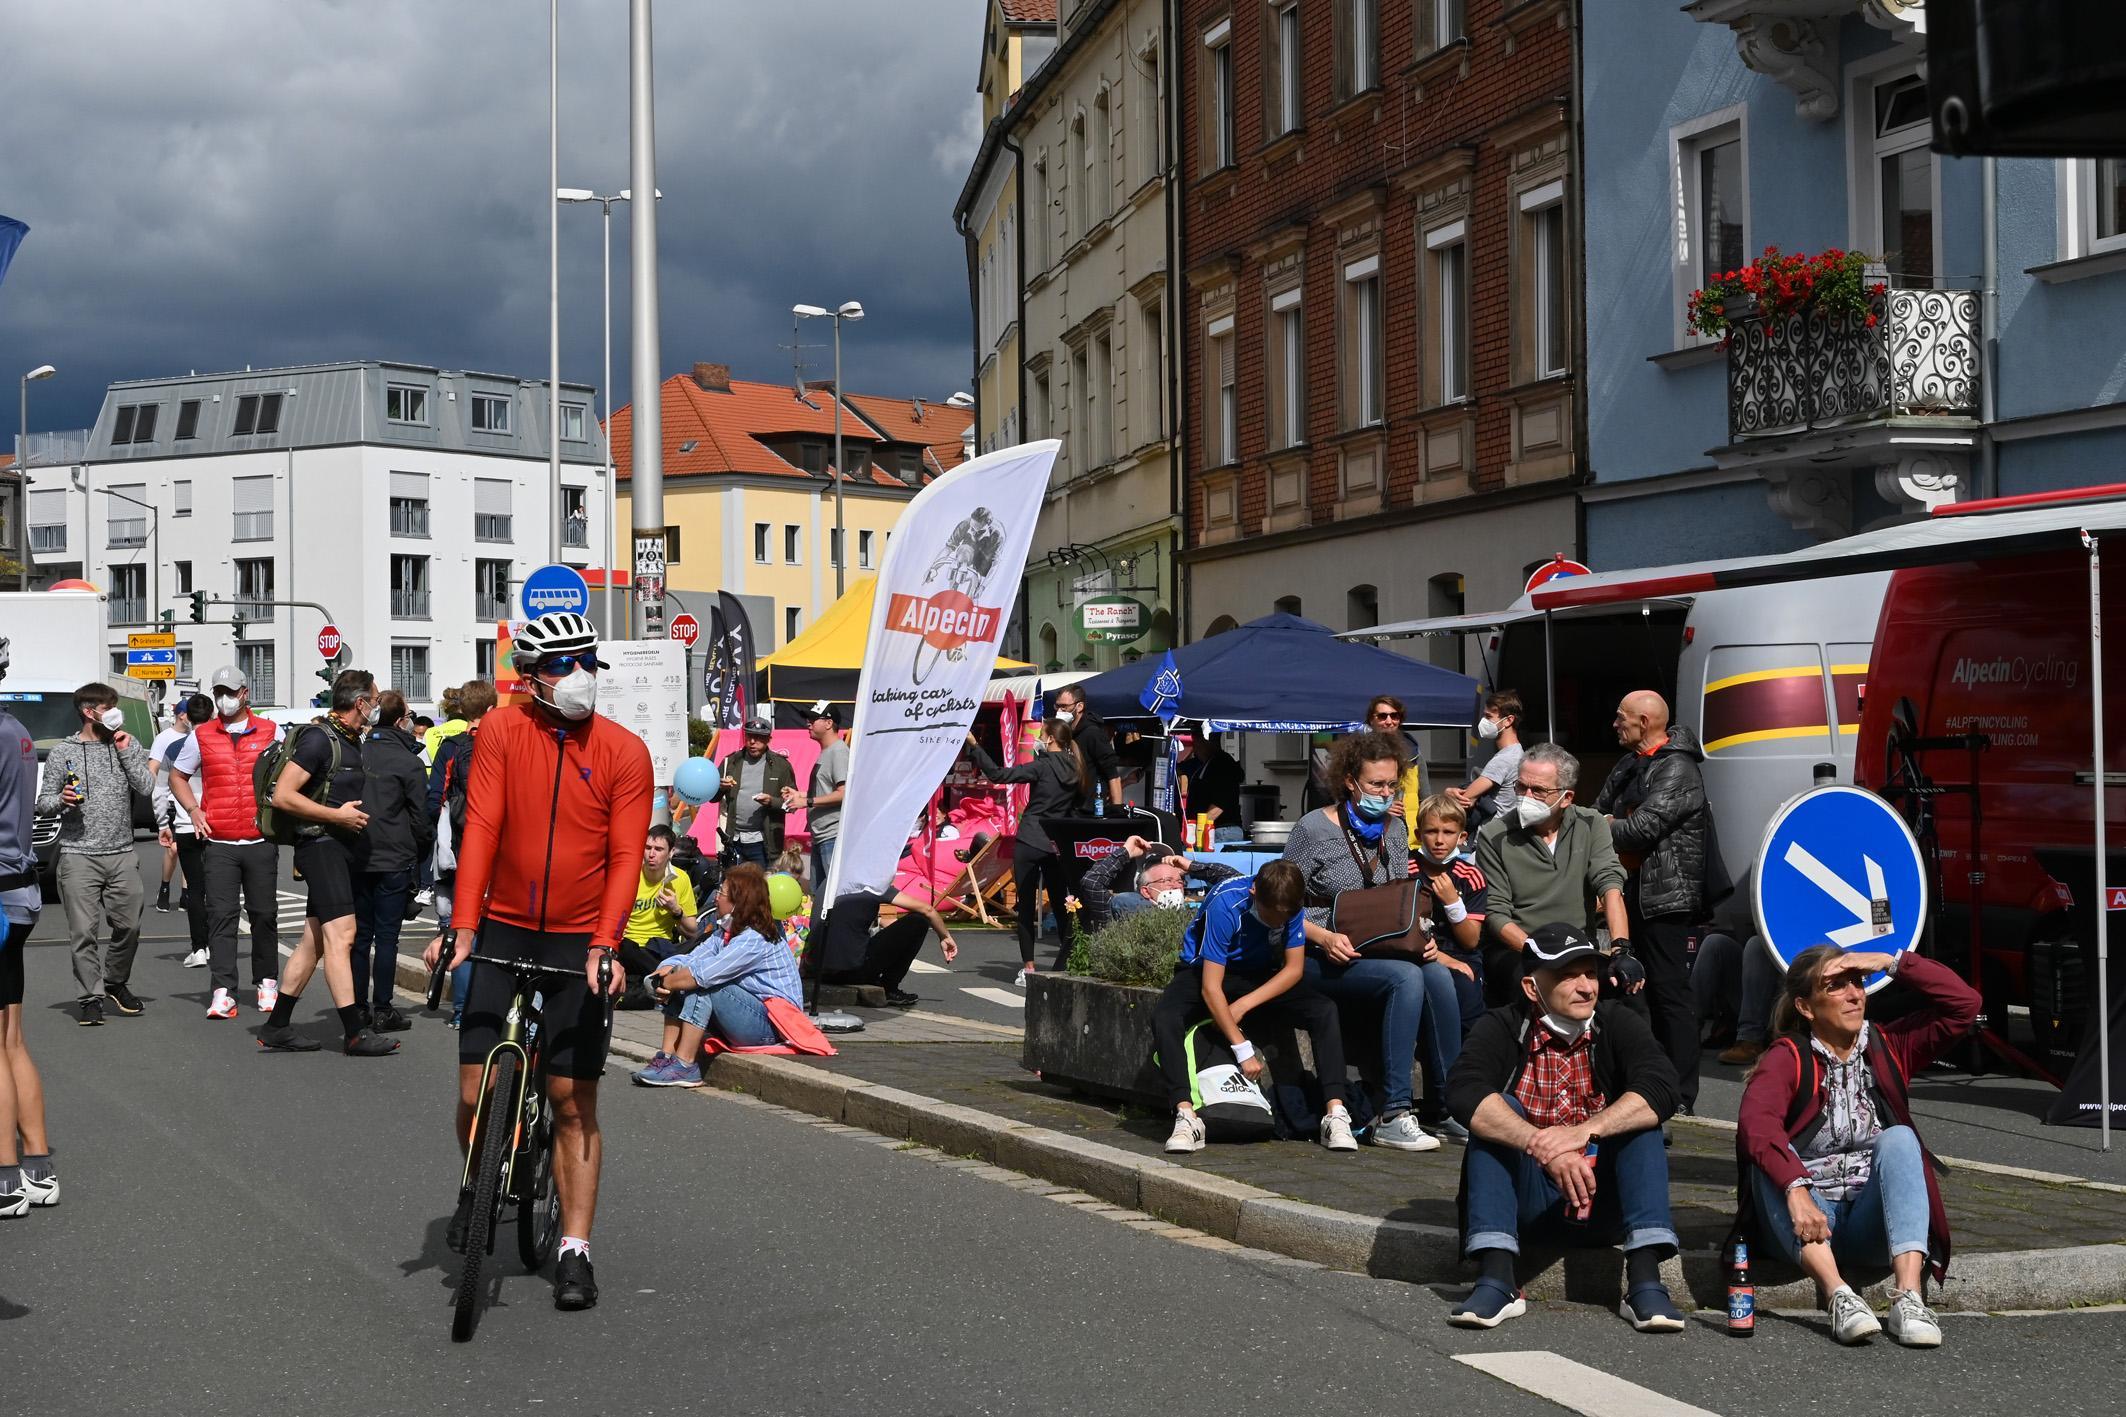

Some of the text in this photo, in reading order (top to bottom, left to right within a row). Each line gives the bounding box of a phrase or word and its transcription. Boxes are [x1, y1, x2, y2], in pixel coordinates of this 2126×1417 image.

[900, 599, 991, 637] Alpecin
[672, 624, 696, 638] STOP
[1106, 632, 1139, 641] Pyraser
[319, 634, 339, 649] STOP
[872, 687, 918, 704] taking
[904, 697, 977, 721] of cyclists
[1235, 721, 1253, 729] FSV
[1945, 716, 2028, 729] #ALPEINCYCLING
